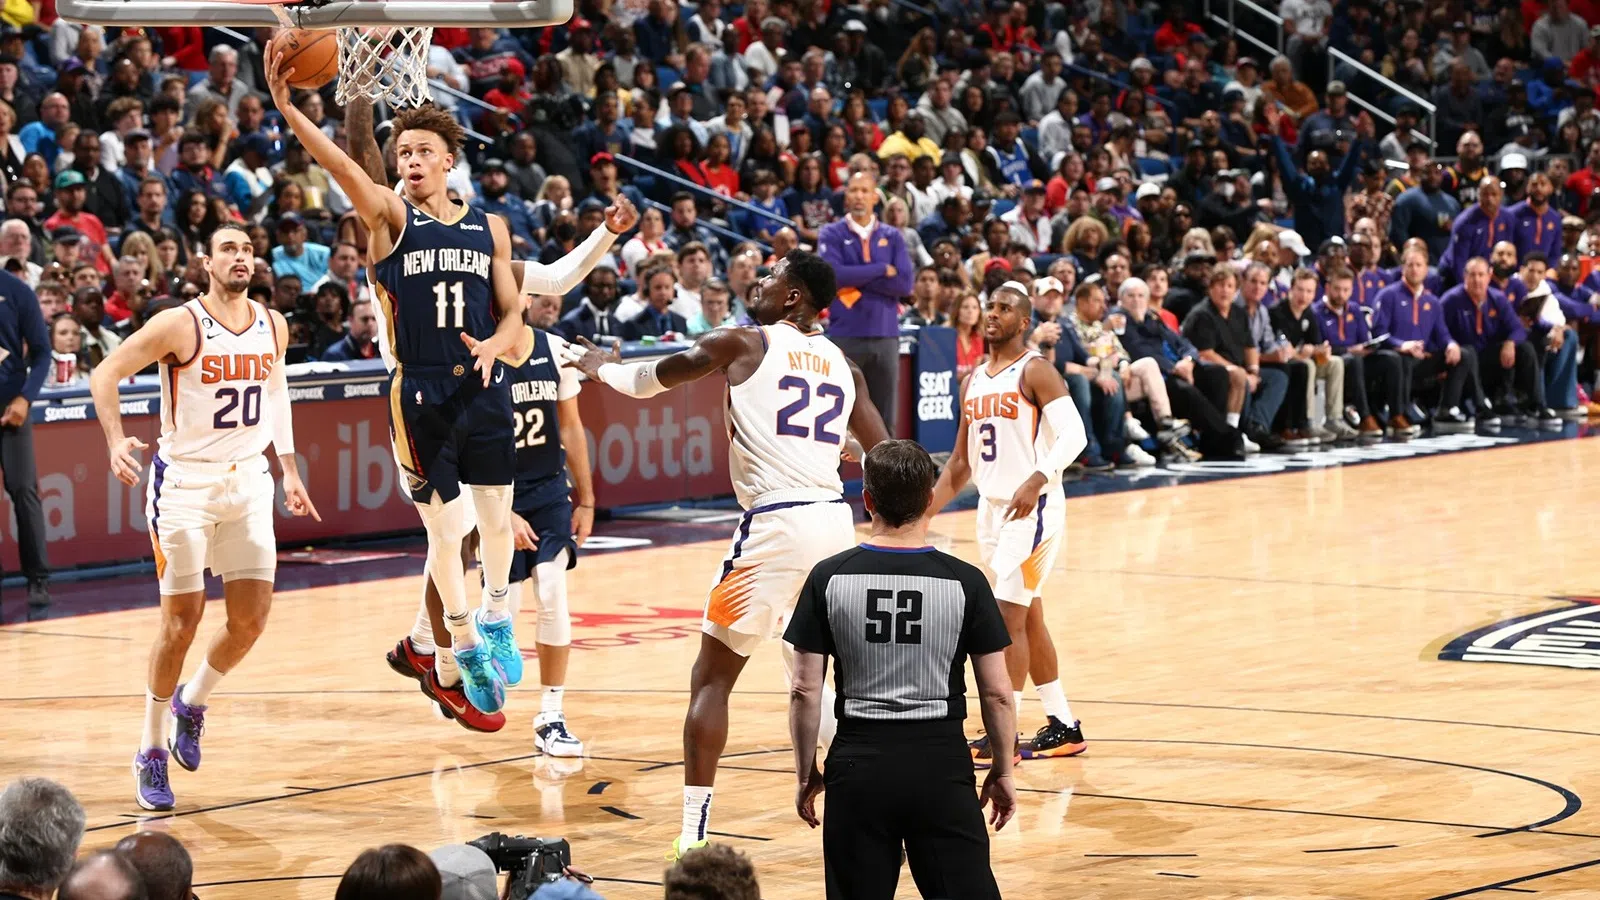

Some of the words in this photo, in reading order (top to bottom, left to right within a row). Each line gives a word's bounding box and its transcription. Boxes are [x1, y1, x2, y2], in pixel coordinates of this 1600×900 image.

[403, 248, 436, 277] NEW
[439, 248, 491, 280] ORLEANS
[432, 281, 466, 328] 11
[787, 351, 831, 378] AYTON
[919, 370, 953, 396] SEAT
[213, 385, 262, 429] 20
[511, 380, 558, 404] ORLEANS
[776, 375, 846, 446] 22
[917, 395, 954, 421] GEEK
[513, 408, 547, 449] 22
[979, 423, 998, 462] 3
[865, 588, 923, 645] 52
